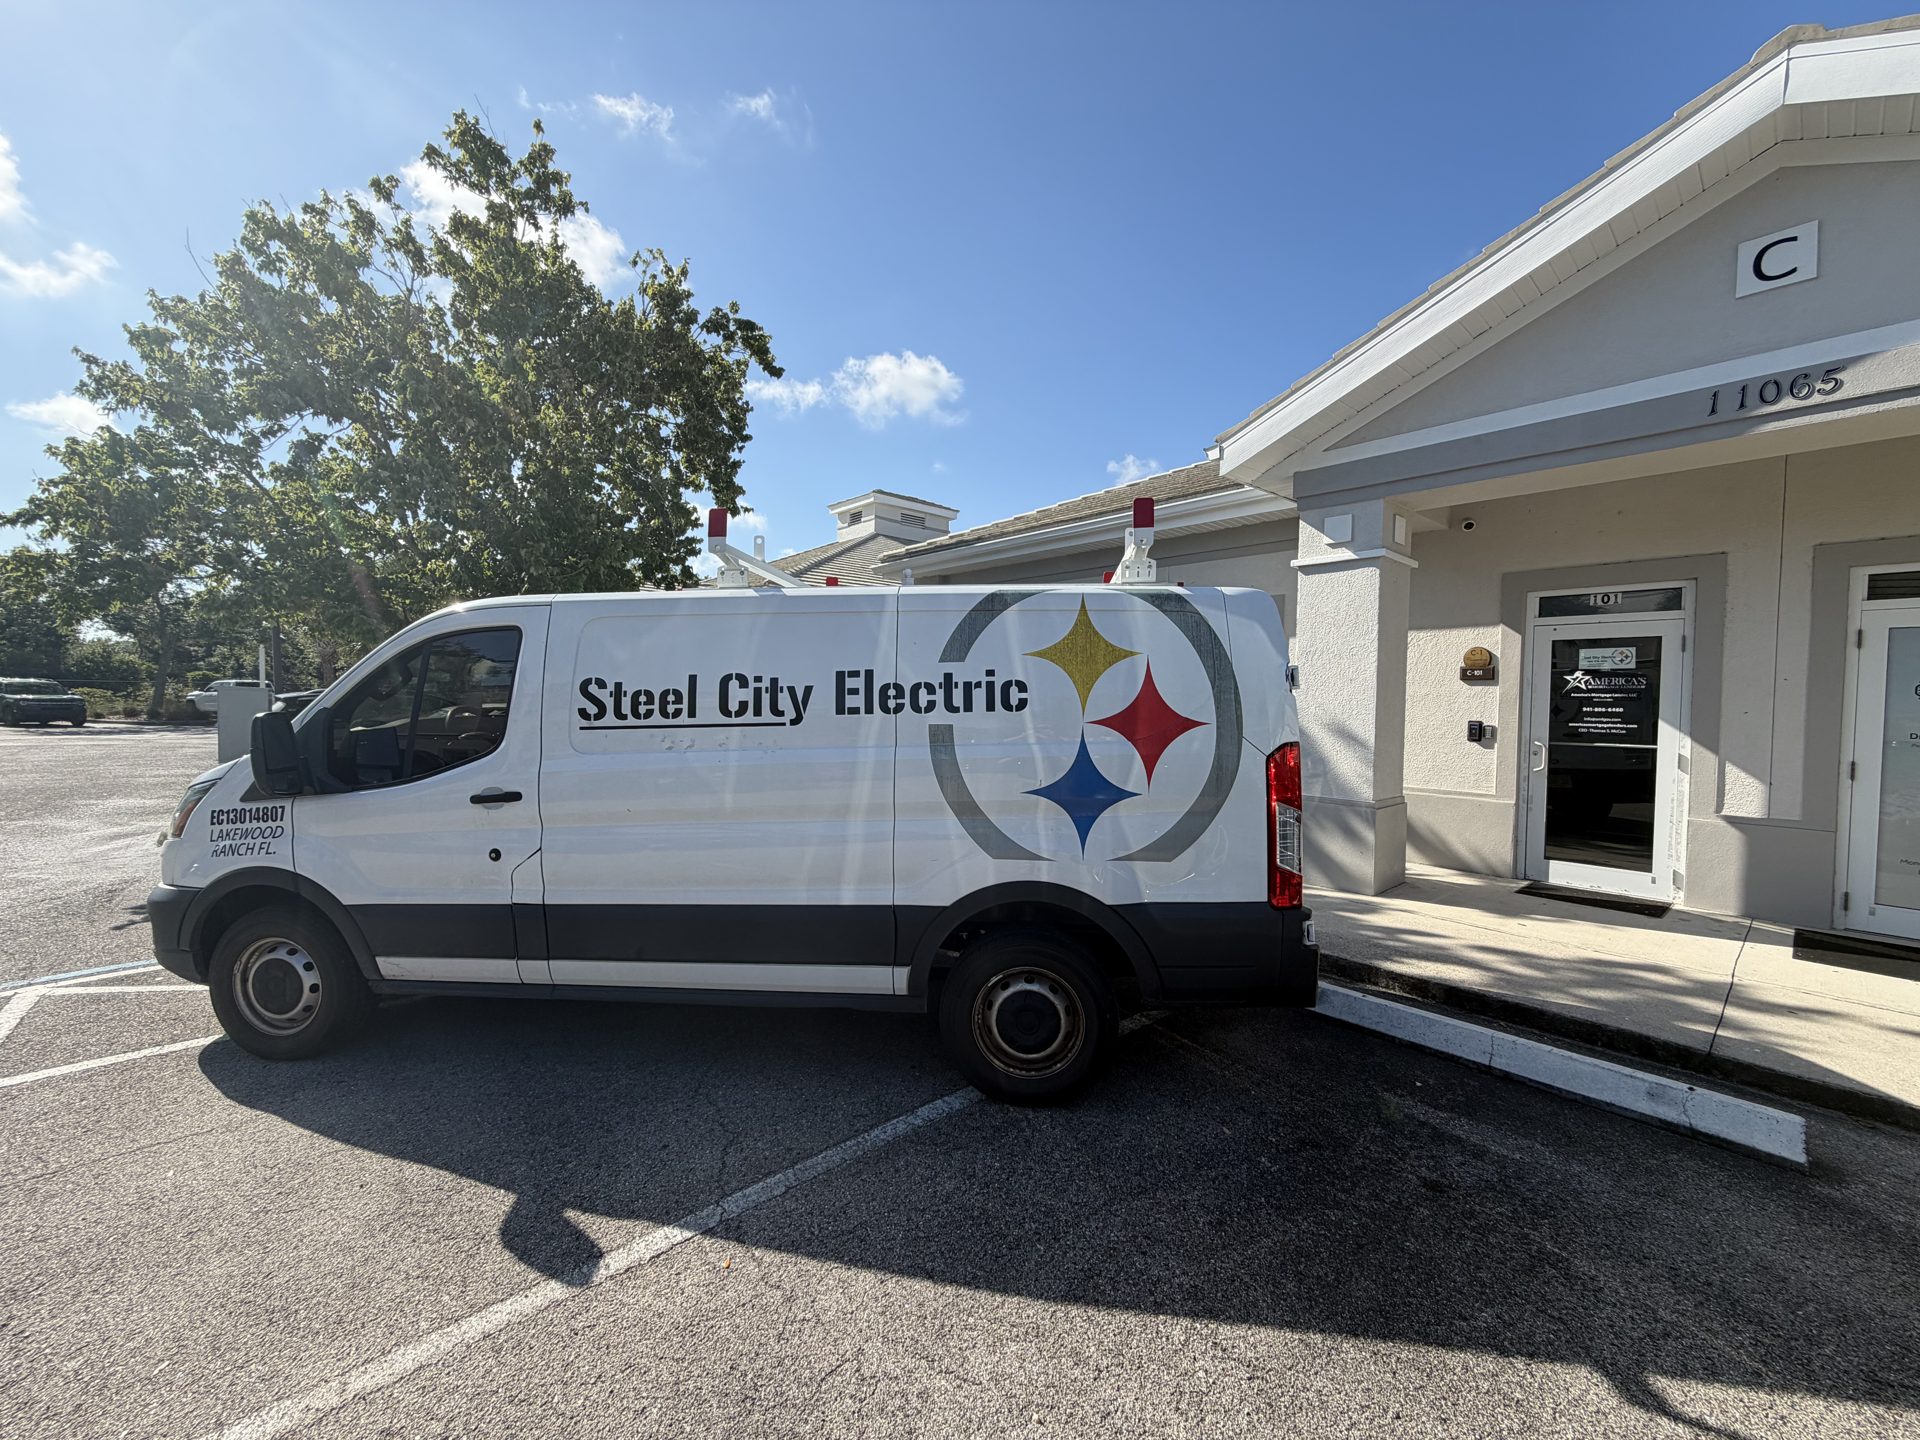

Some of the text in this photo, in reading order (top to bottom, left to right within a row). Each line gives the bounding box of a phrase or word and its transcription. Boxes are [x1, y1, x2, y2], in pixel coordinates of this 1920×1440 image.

[1753, 236, 1798, 281] C
[1707, 365, 1844, 416] 11065
[1592, 594, 1619, 604] 101
[1586, 677, 1647, 685] AMERICA'S
[577, 669, 1029, 726] Steel City Electric
[210, 805, 286, 826] EC13014807
[210, 825, 284, 843] LAKEWOOD
[211, 842, 276, 858] RANCH FL.
